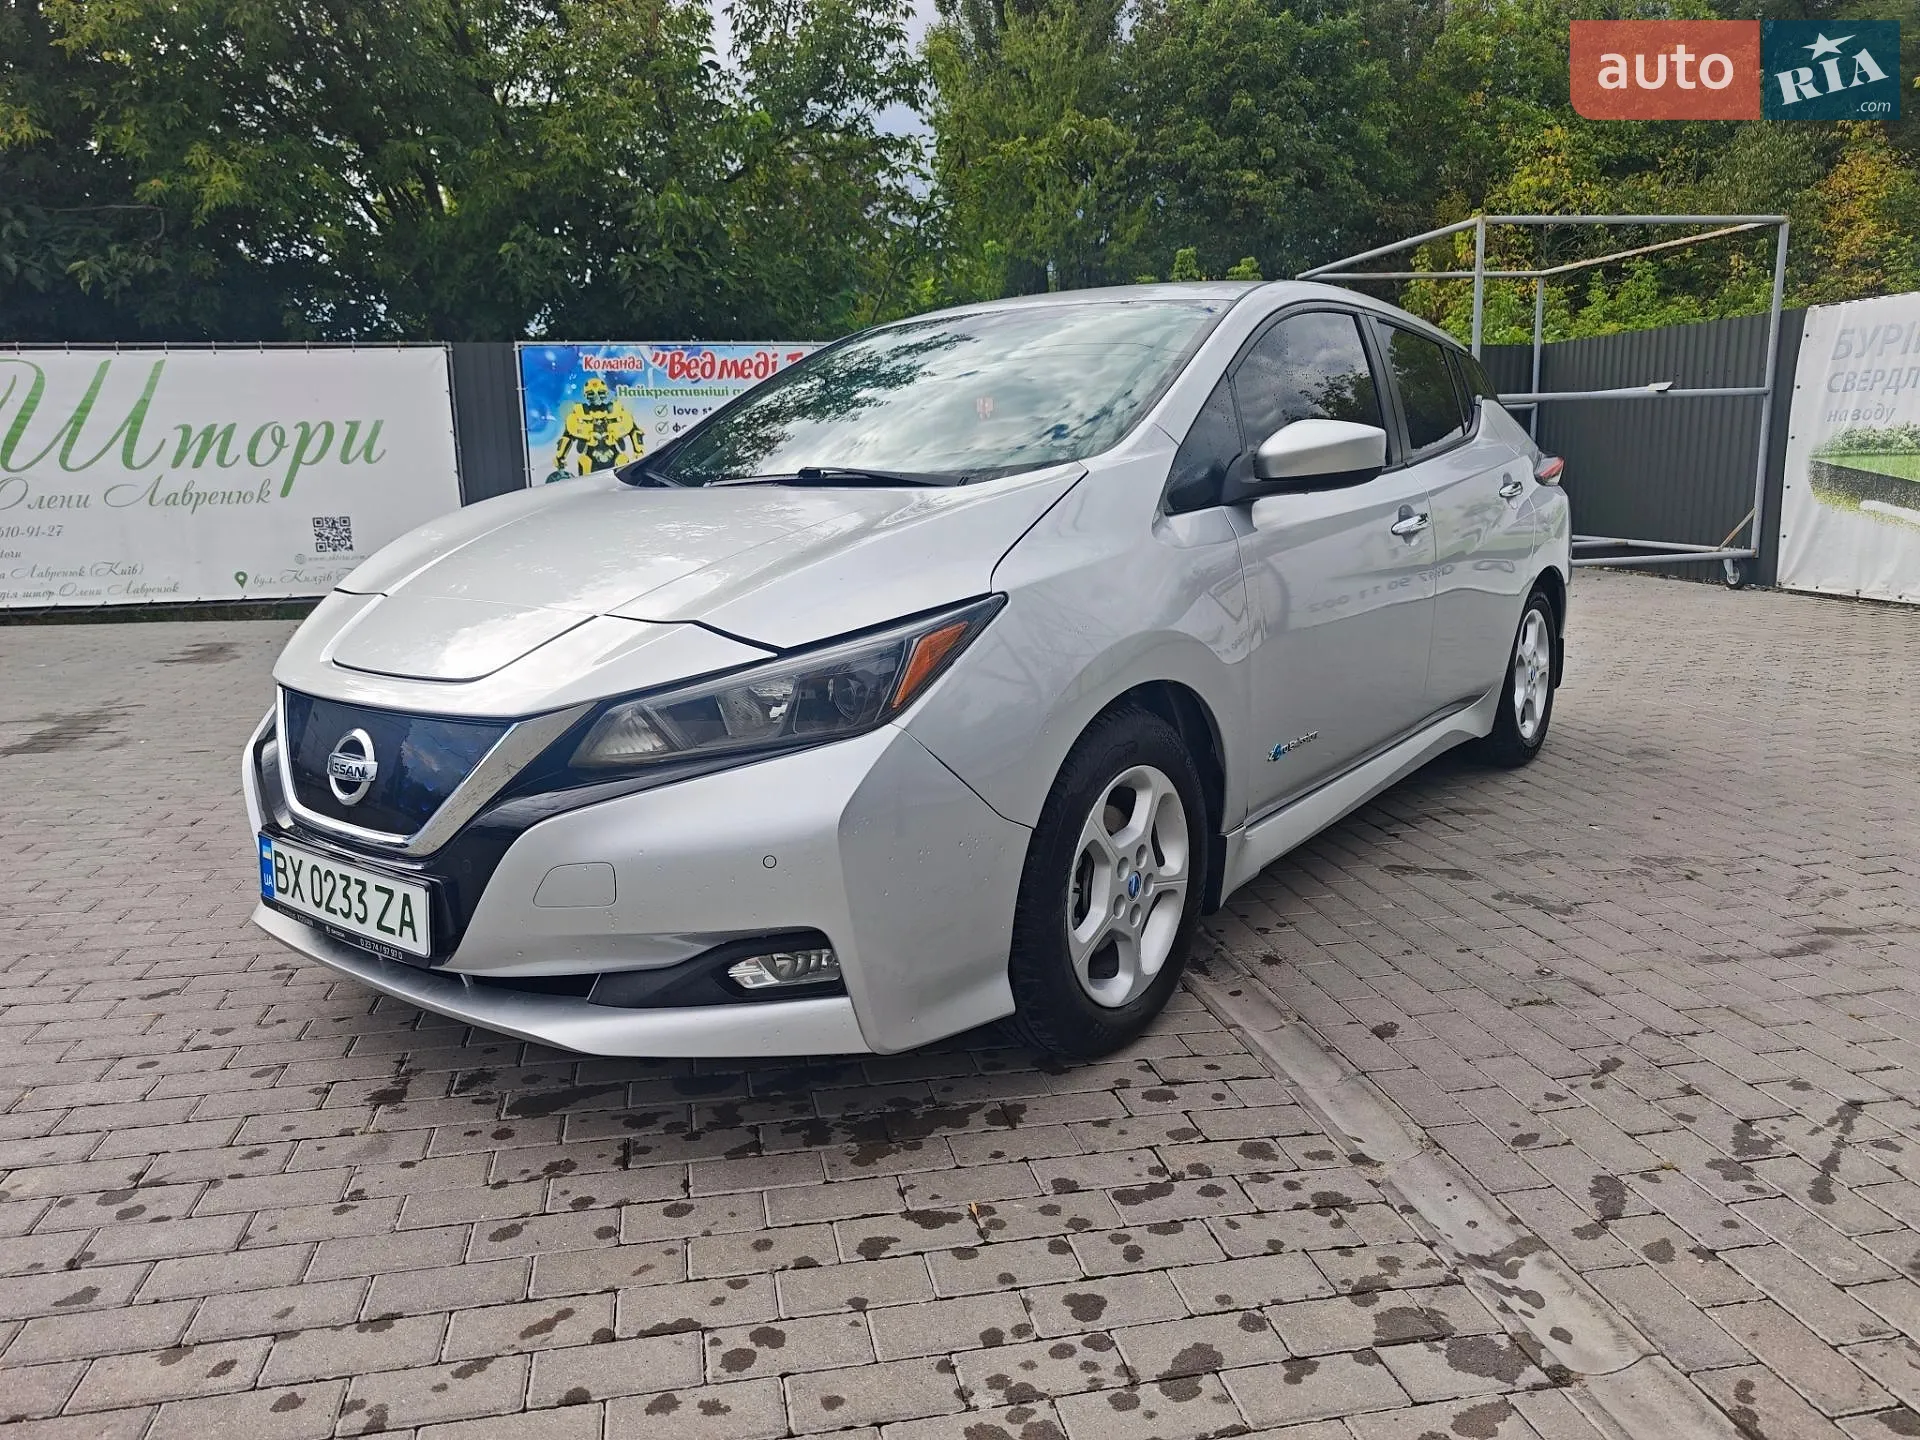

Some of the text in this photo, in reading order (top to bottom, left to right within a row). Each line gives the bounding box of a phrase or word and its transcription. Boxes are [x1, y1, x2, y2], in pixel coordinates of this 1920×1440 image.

[584, 355, 643, 370] Команда
[618, 385, 730, 399] Найкреативніші
[672, 405, 699, 416] love
[1827, 402, 1896, 425] на воду
[0, 358, 387, 498] Штори
[0, 474, 272, 515] Олени Лавренюк
[264, 872, 274, 888] UA
[273, 849, 418, 943] BX 0233 ZA
